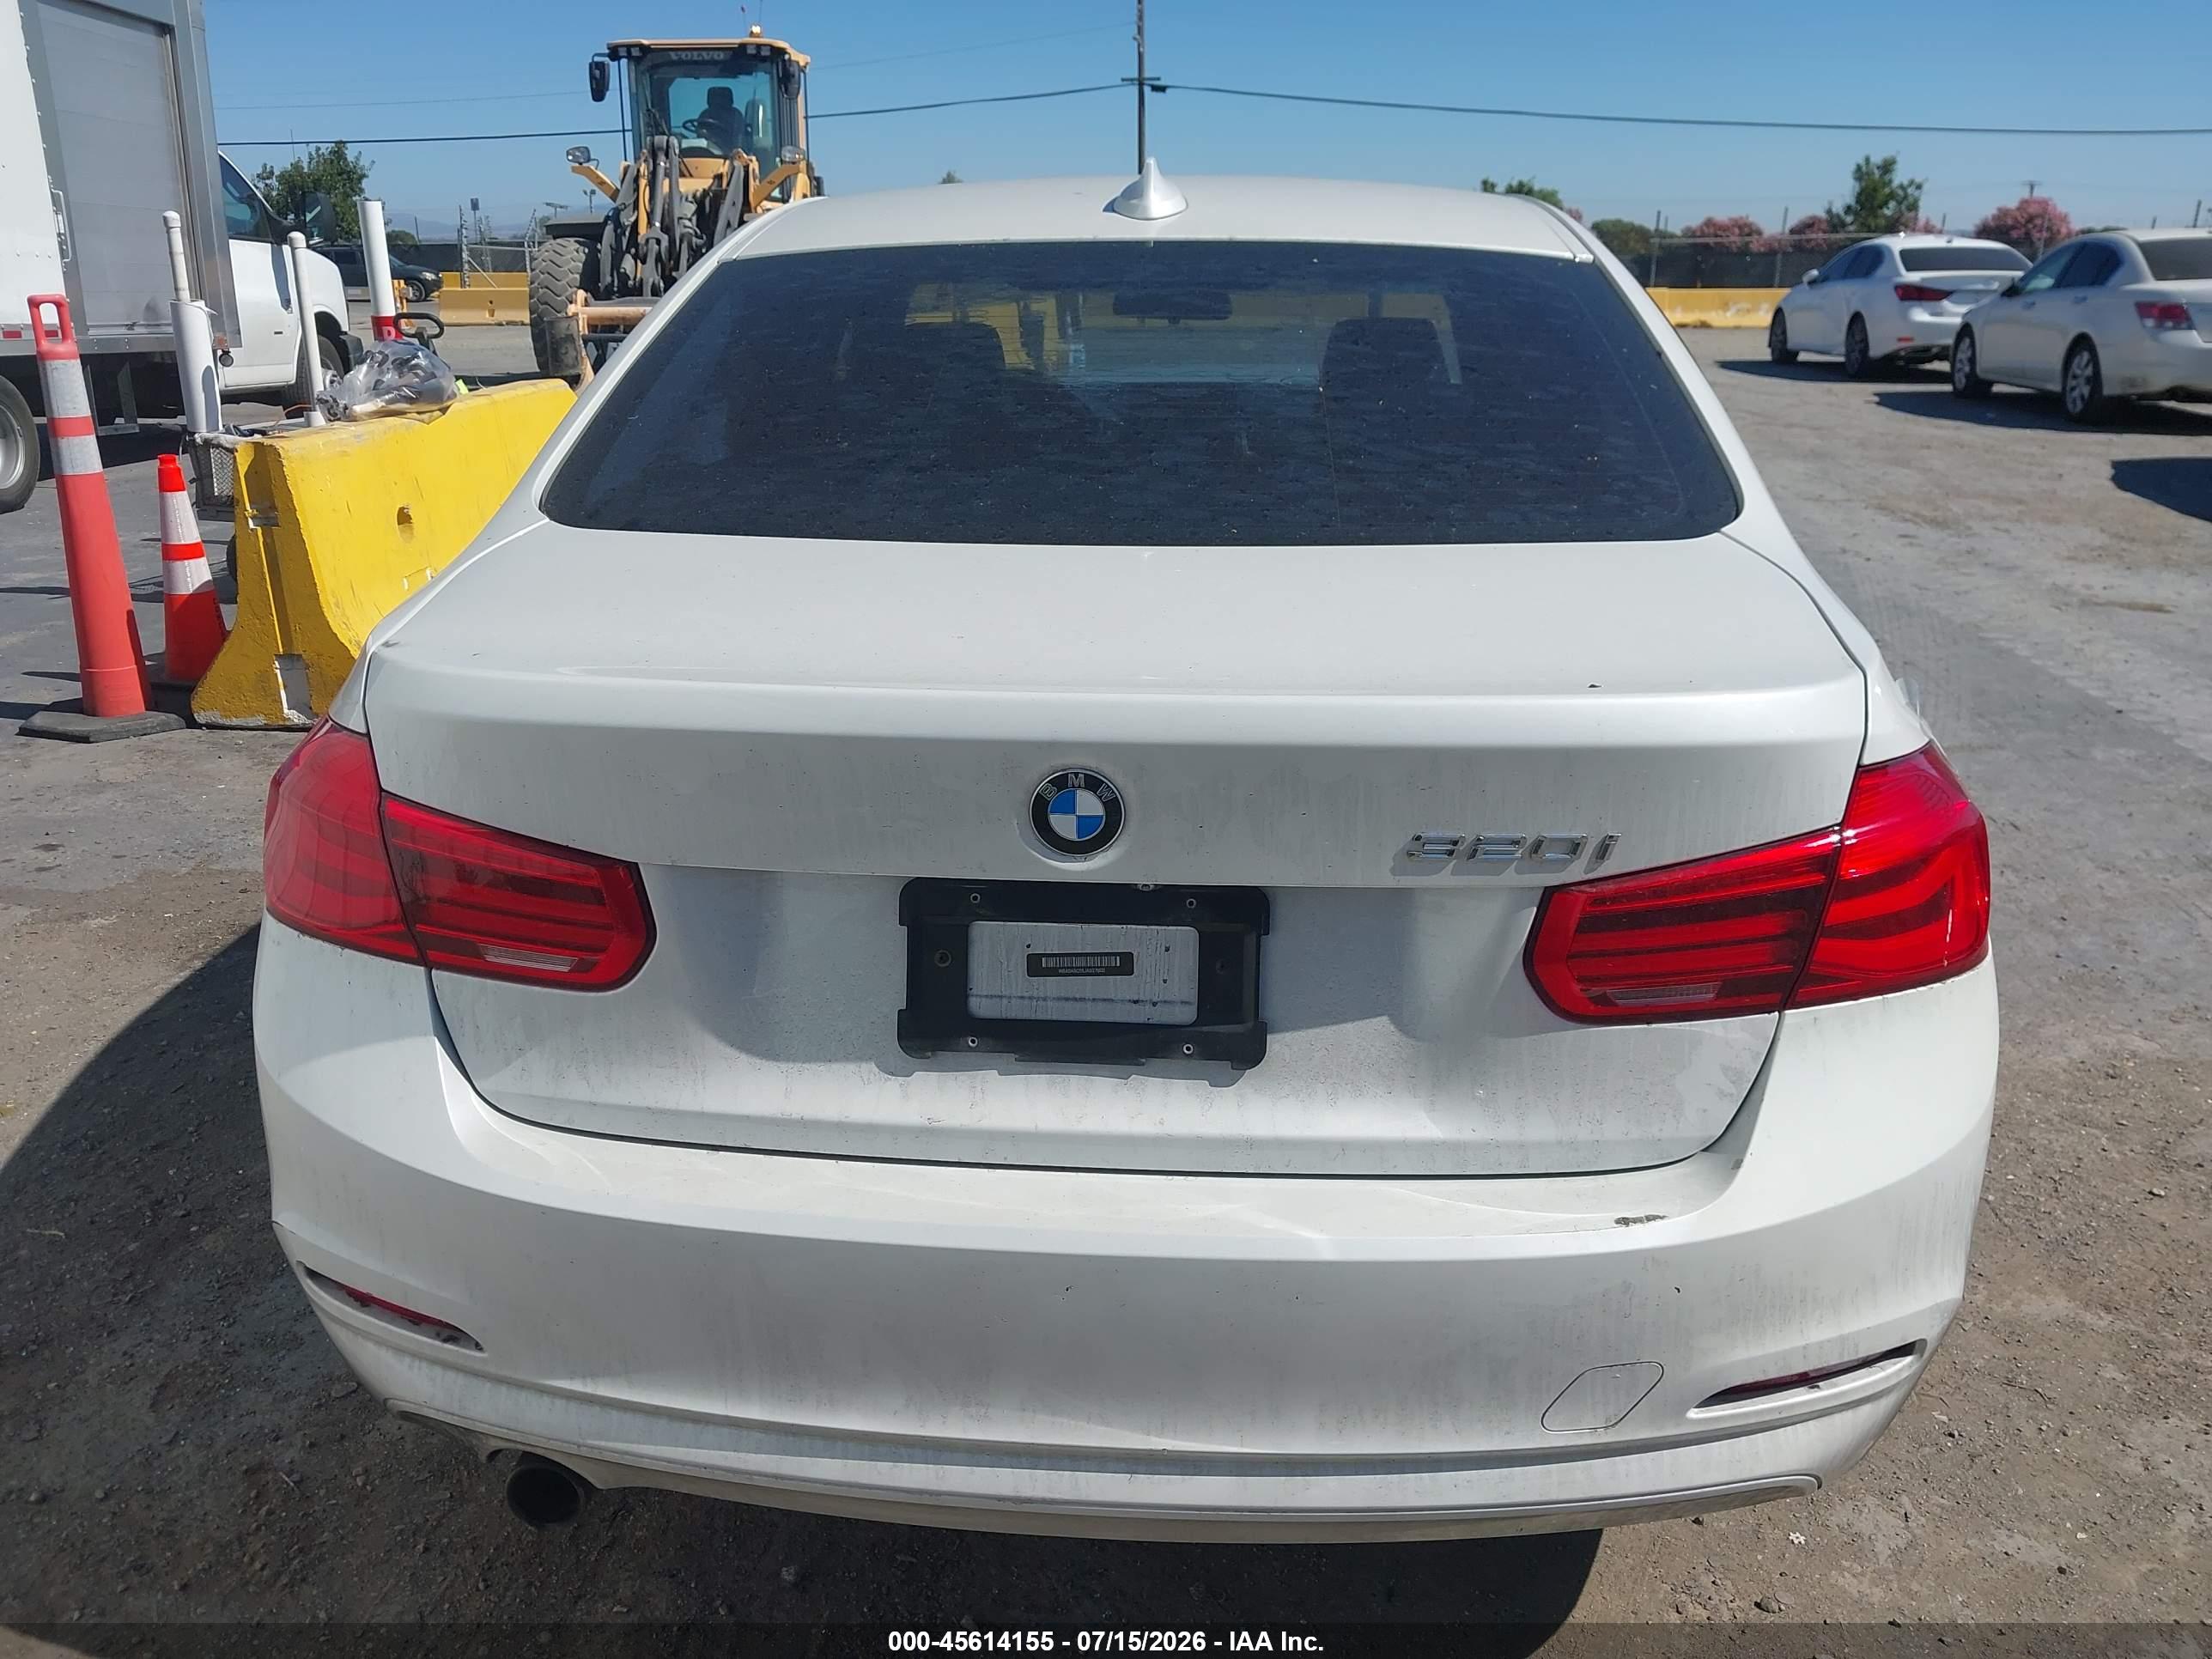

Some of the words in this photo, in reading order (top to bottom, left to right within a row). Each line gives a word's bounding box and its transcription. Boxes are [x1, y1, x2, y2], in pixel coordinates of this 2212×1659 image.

[670, 52, 724, 60] VOLVO
[1039, 773, 1115, 802] BMW
[1407, 831, 1621, 861] 320i
